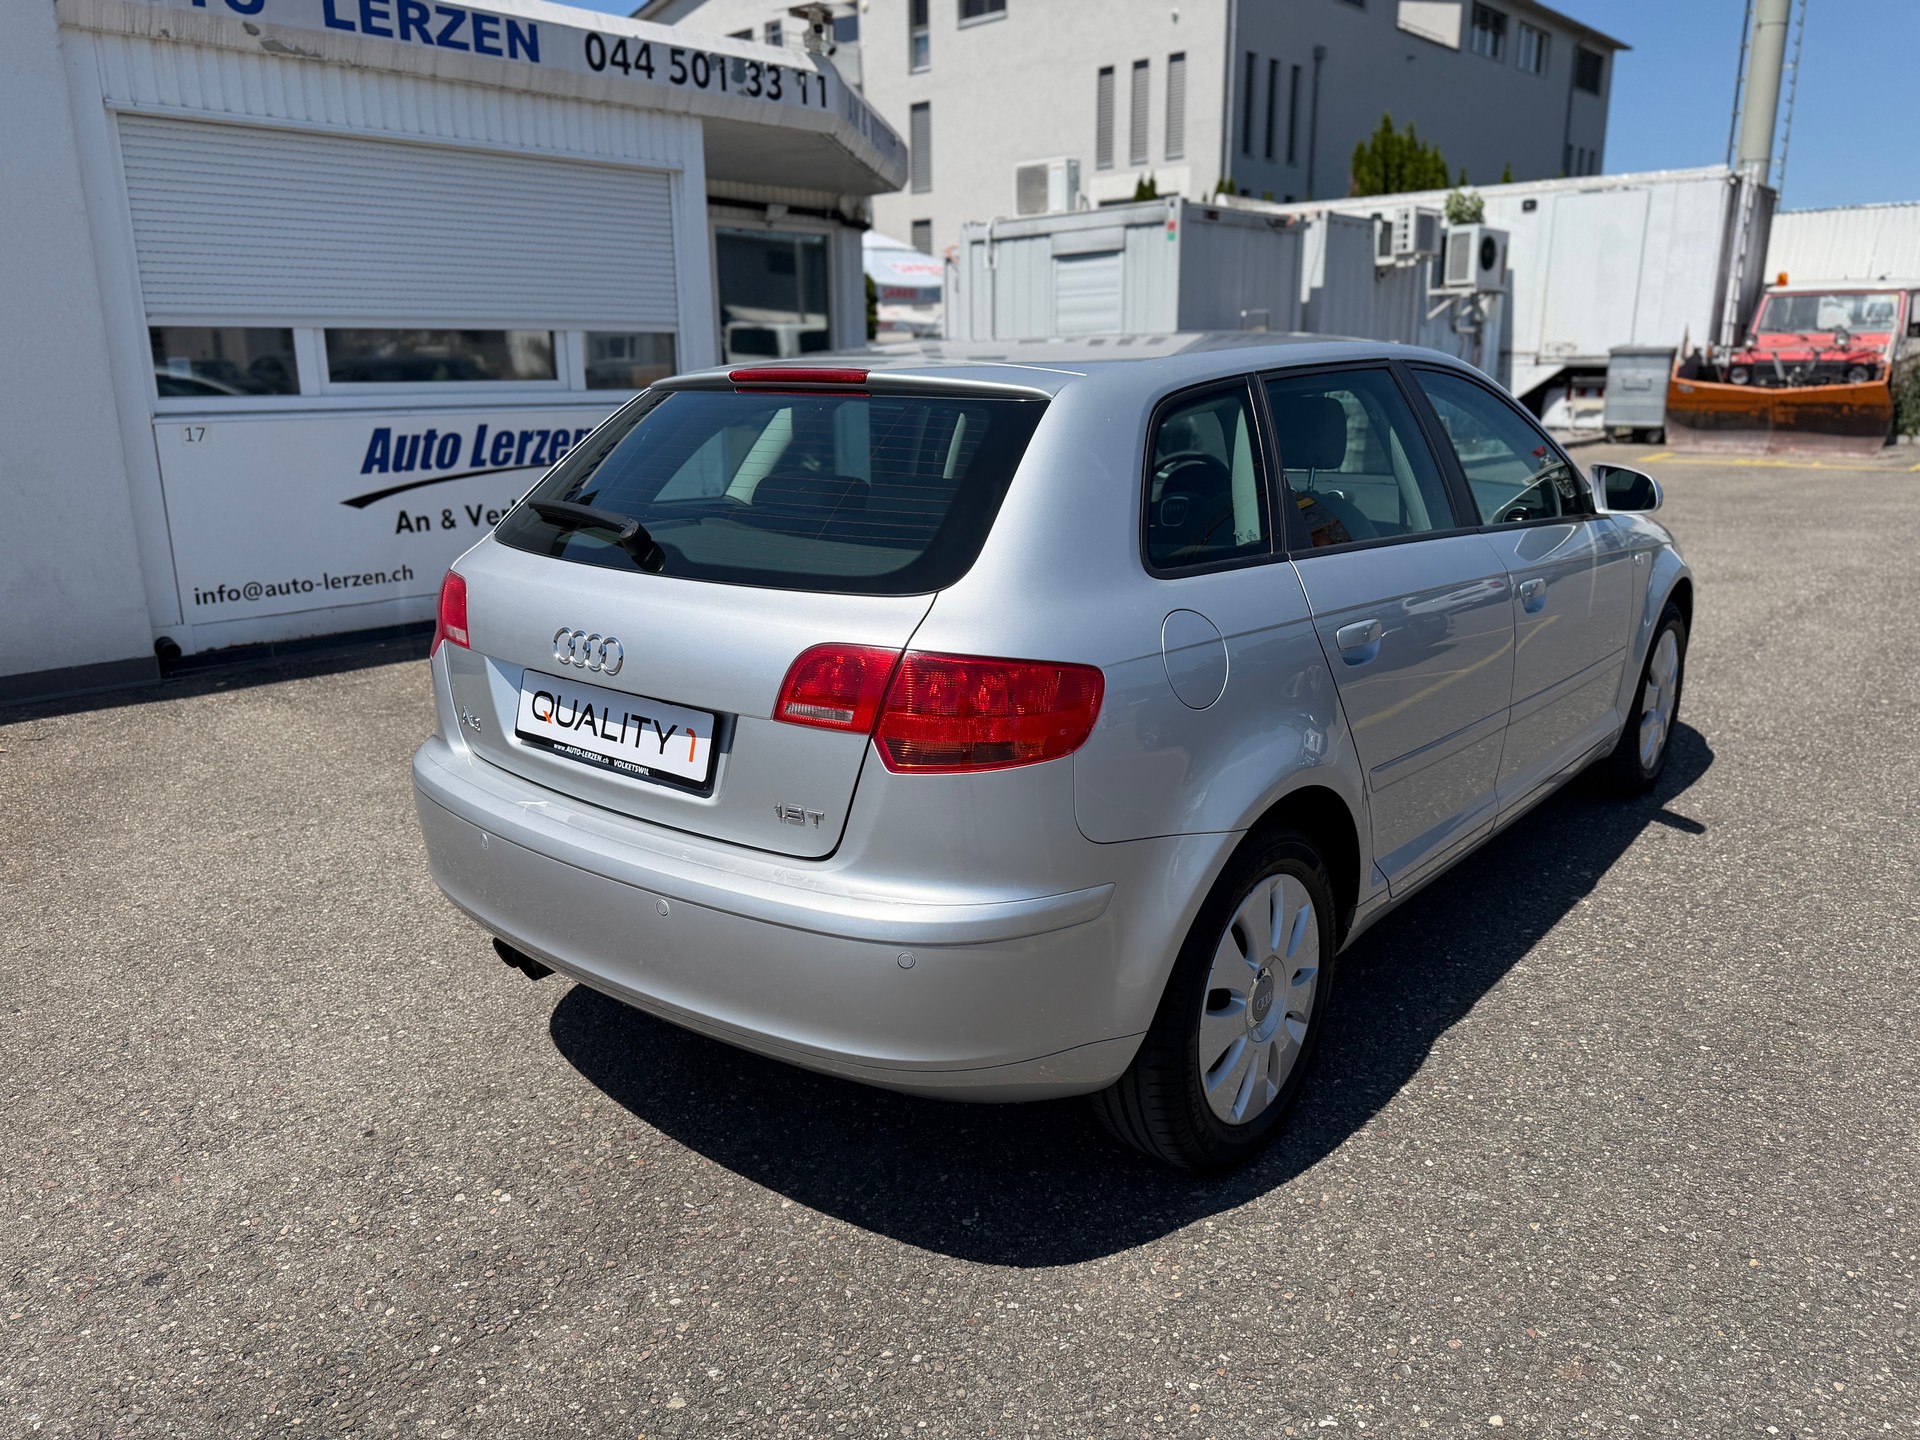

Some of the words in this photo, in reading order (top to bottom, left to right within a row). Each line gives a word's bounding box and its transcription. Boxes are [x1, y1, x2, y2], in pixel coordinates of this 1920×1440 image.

[322, 0, 540, 63] LERZEN
[585, 32, 655, 80] 044
[669, 48, 727, 92] 501
[746, 62, 782, 101] 33
[799, 72, 827, 108] 11
[185, 427, 206, 442] 17
[360, 427, 462, 475] Auto
[396, 510, 431, 534] An
[441, 509, 457, 530] &
[194, 565, 414, 606] info@auto-lerzen.ch
[613, 759, 650, 776] VOLKETSWIL
